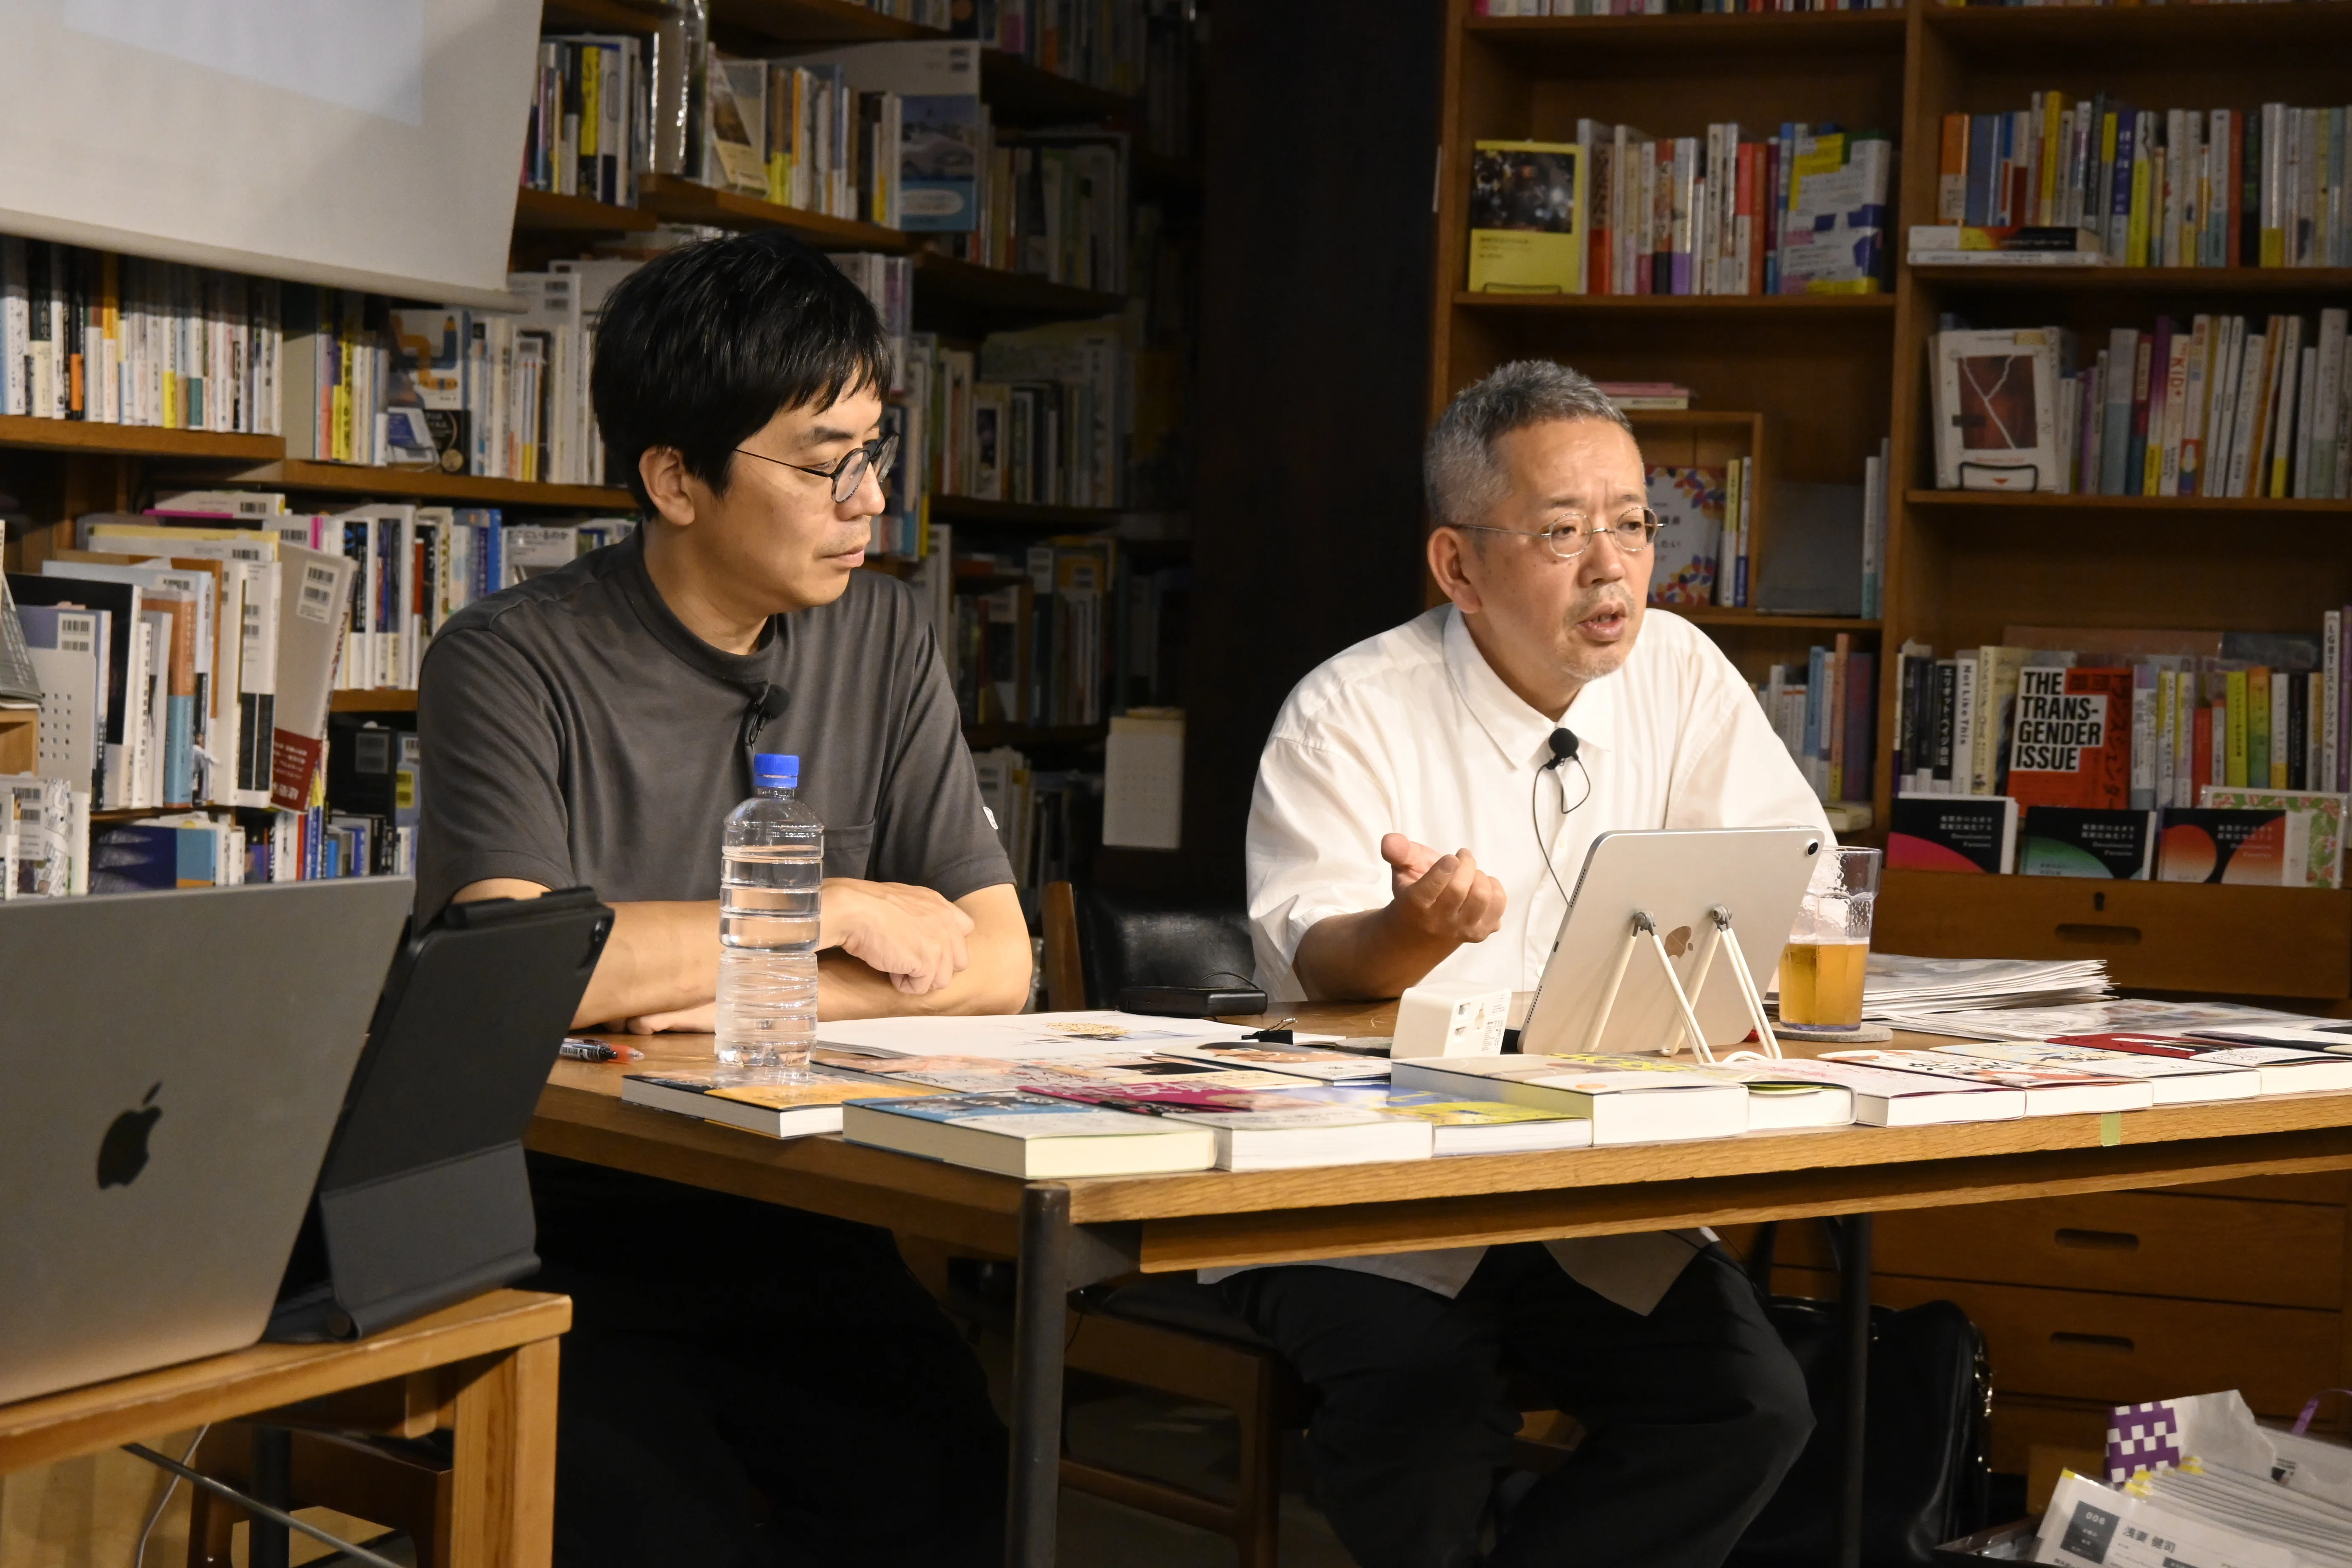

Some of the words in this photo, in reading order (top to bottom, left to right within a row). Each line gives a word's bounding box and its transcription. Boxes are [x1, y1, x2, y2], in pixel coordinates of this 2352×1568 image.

[1963, 665, 1972, 686] Not
[2023, 672, 2062, 695] THE
[1961, 691, 1971, 716] Like
[2021, 697, 2099, 721] TRANS-
[1960, 720, 1970, 745] This
[2019, 721, 2101, 745] GENDER
[2015, 746, 2078, 770] ISSUE
[2085, 1512, 2106, 1525] 008
[2151, 1536, 2176, 1553] 健司
